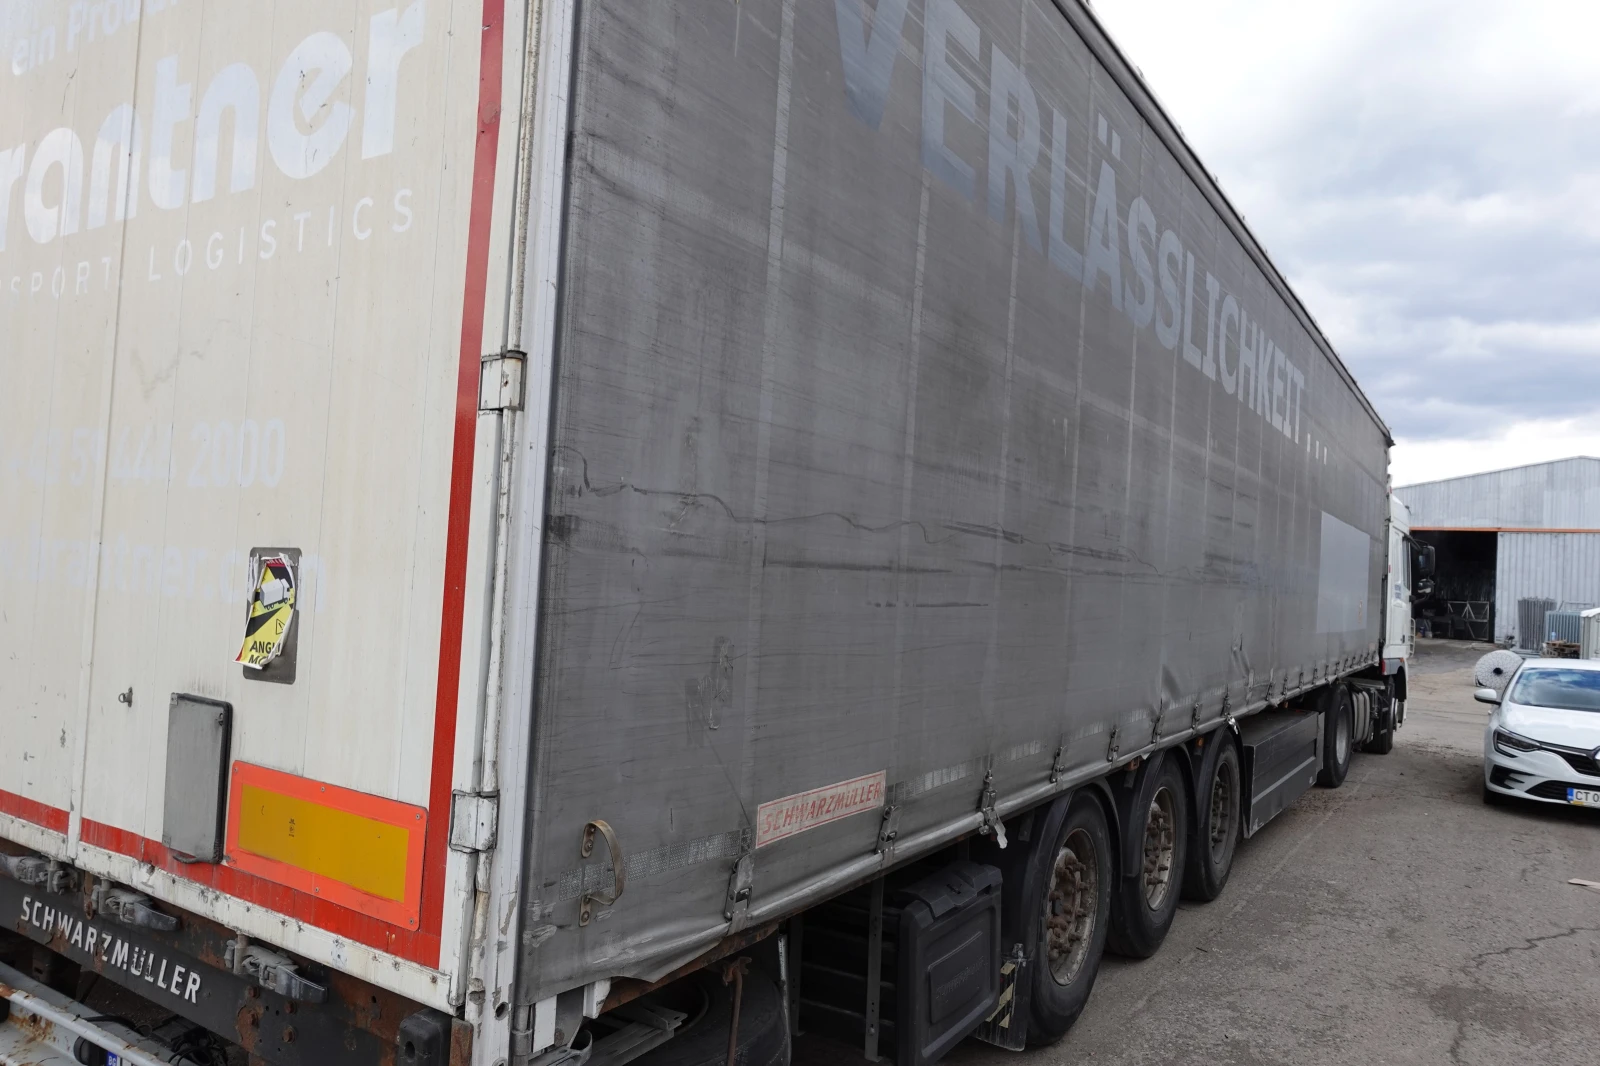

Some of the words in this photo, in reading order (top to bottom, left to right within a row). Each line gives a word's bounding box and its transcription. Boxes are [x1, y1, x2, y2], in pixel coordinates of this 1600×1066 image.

[148, 187, 413, 282] LOGISTICS
[187, 418, 287, 488] 2000
[762, 781, 882, 835] SCHWARZMÜLLER
[1575, 790, 1591, 802] CT
[20, 896, 202, 1004] SCHWARZMÜLLER
